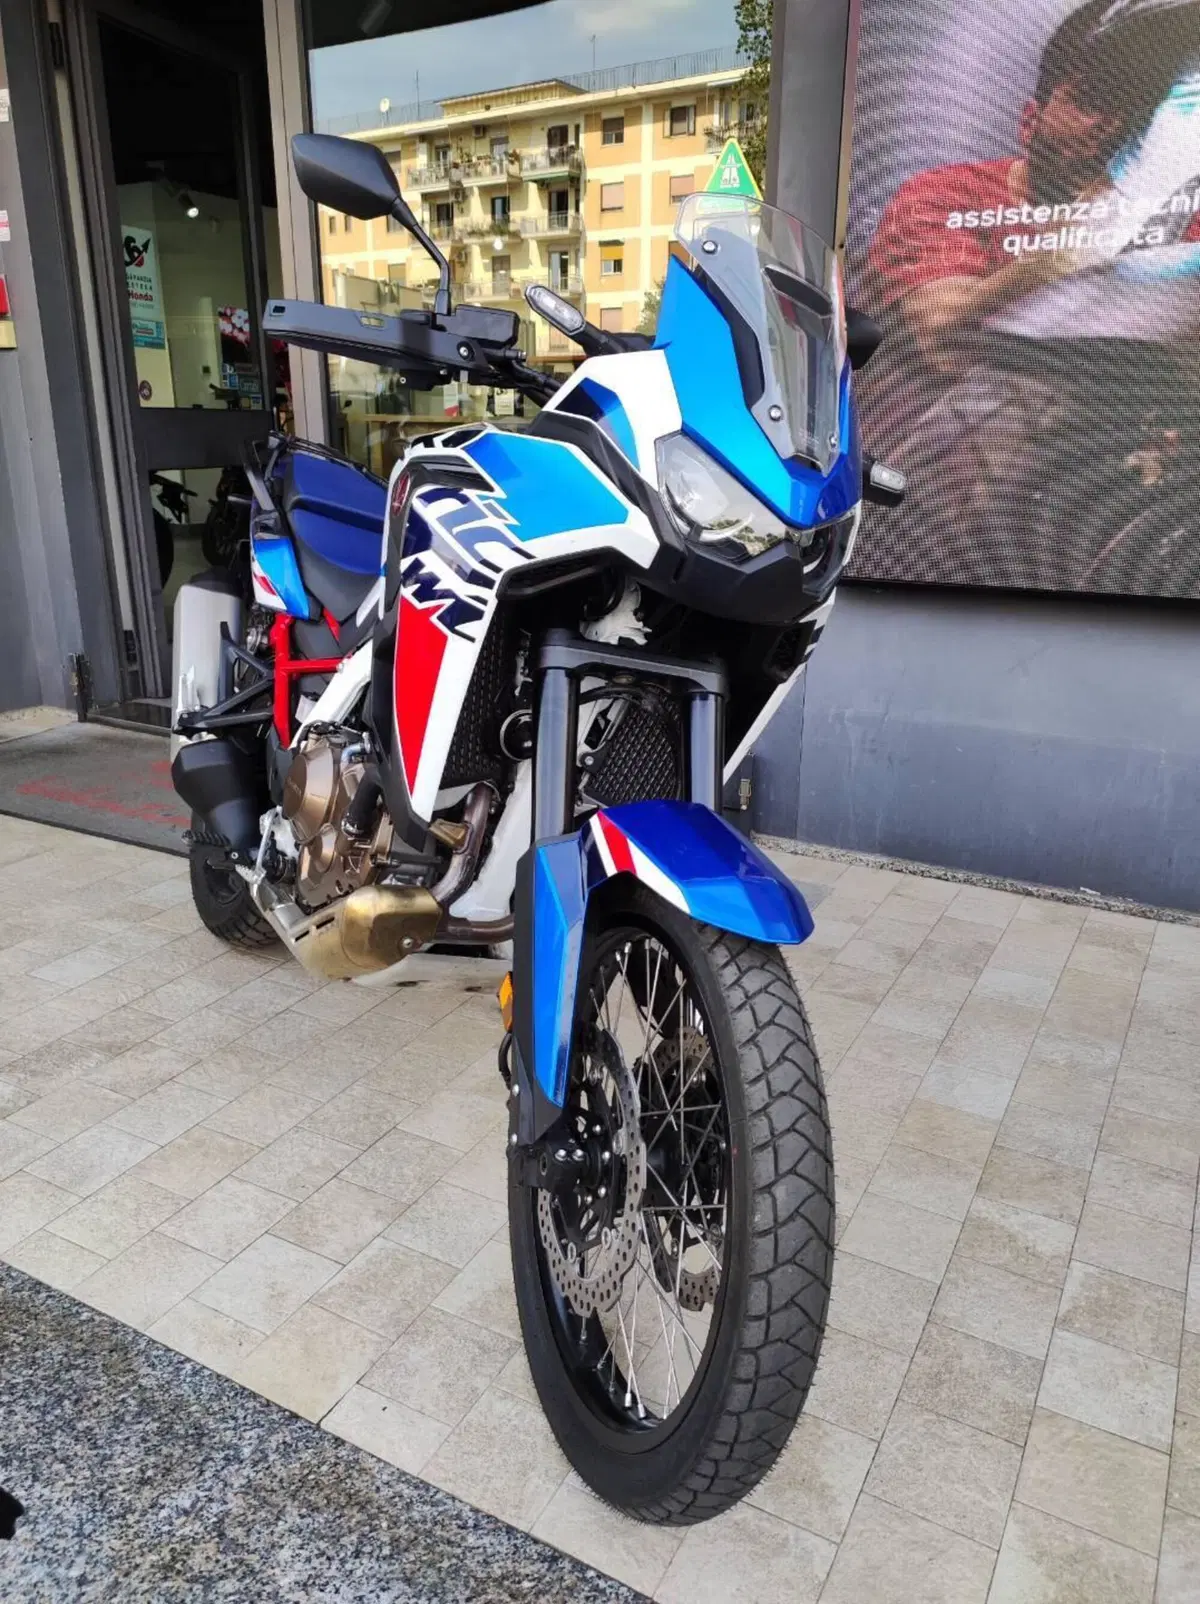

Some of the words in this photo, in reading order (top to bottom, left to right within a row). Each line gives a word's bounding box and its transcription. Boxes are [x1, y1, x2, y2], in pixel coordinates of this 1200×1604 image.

[946, 199, 1109, 229] assistenza
[1118, 188, 1200, 217] tcni
[1003, 223, 1165, 255] qualificta
